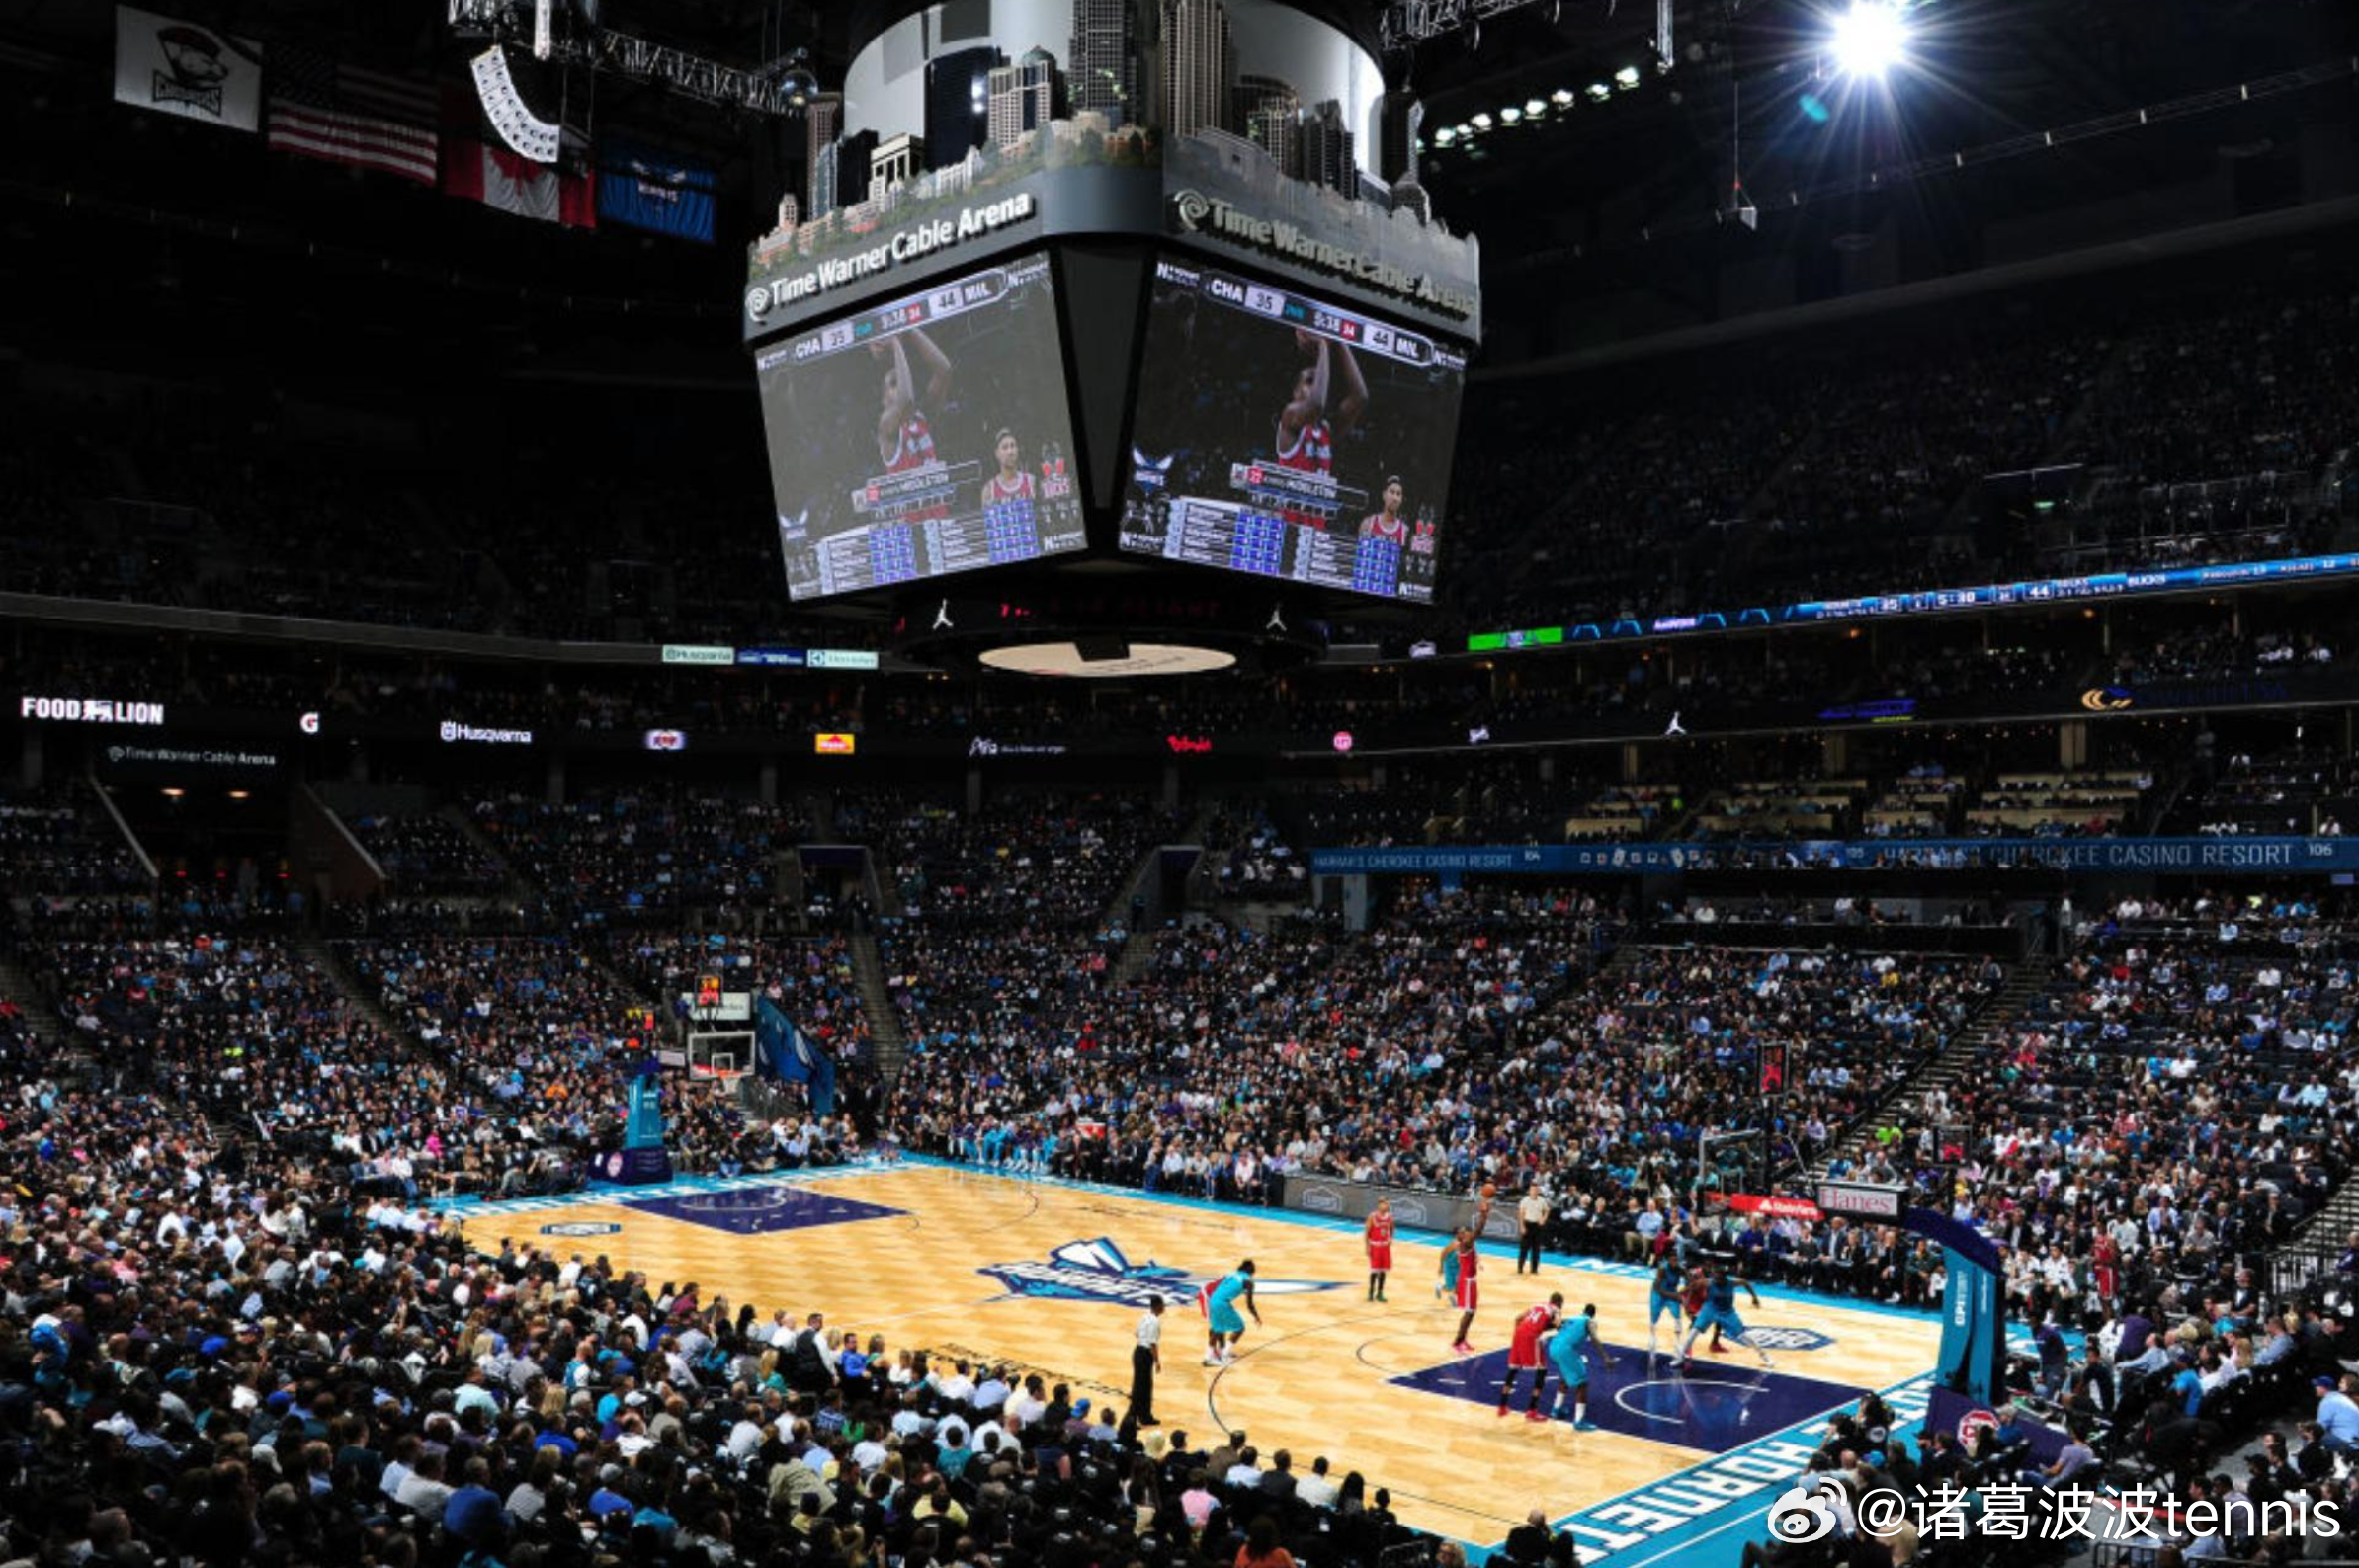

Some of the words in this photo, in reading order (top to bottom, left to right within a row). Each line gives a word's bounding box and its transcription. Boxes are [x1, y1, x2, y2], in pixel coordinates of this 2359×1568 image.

[770, 271, 817, 306] Time
[817, 244, 891, 289] Warner
[891, 219, 953, 261] Cable
[956, 193, 1031, 238] Arena
[1208, 197, 1272, 244] Time
[1271, 218, 1349, 270] Warner
[1349, 253, 1416, 290] Cable
[1415, 272, 1478, 314] Arena
[1211, 278, 1244, 303] CHA
[1256, 292, 1273, 311] 35
[1395, 338, 1419, 360] MIL
[795, 337, 821, 359] CHA
[2128, 573, 2166, 587] BUCKS
[22, 696, 81, 720] FOOD
[114, 701, 165, 725] LION
[300, 712, 320, 735] G
[457, 723, 532, 745] Husqvarna
[126, 747, 155, 761] Time
[157, 749, 201, 763] Warner
[203, 751, 237, 764] Cable
[238, 753, 276, 766] Arena
[1469, 852, 1513, 867] RESORT
[1525, 850, 1541, 862] 104
[2109, 844, 2192, 866] CASINO
[2203, 843, 2293, 865] RESORT
[2309, 844, 2333, 856] 106
[1820, 1188, 1895, 1212] Hanes
